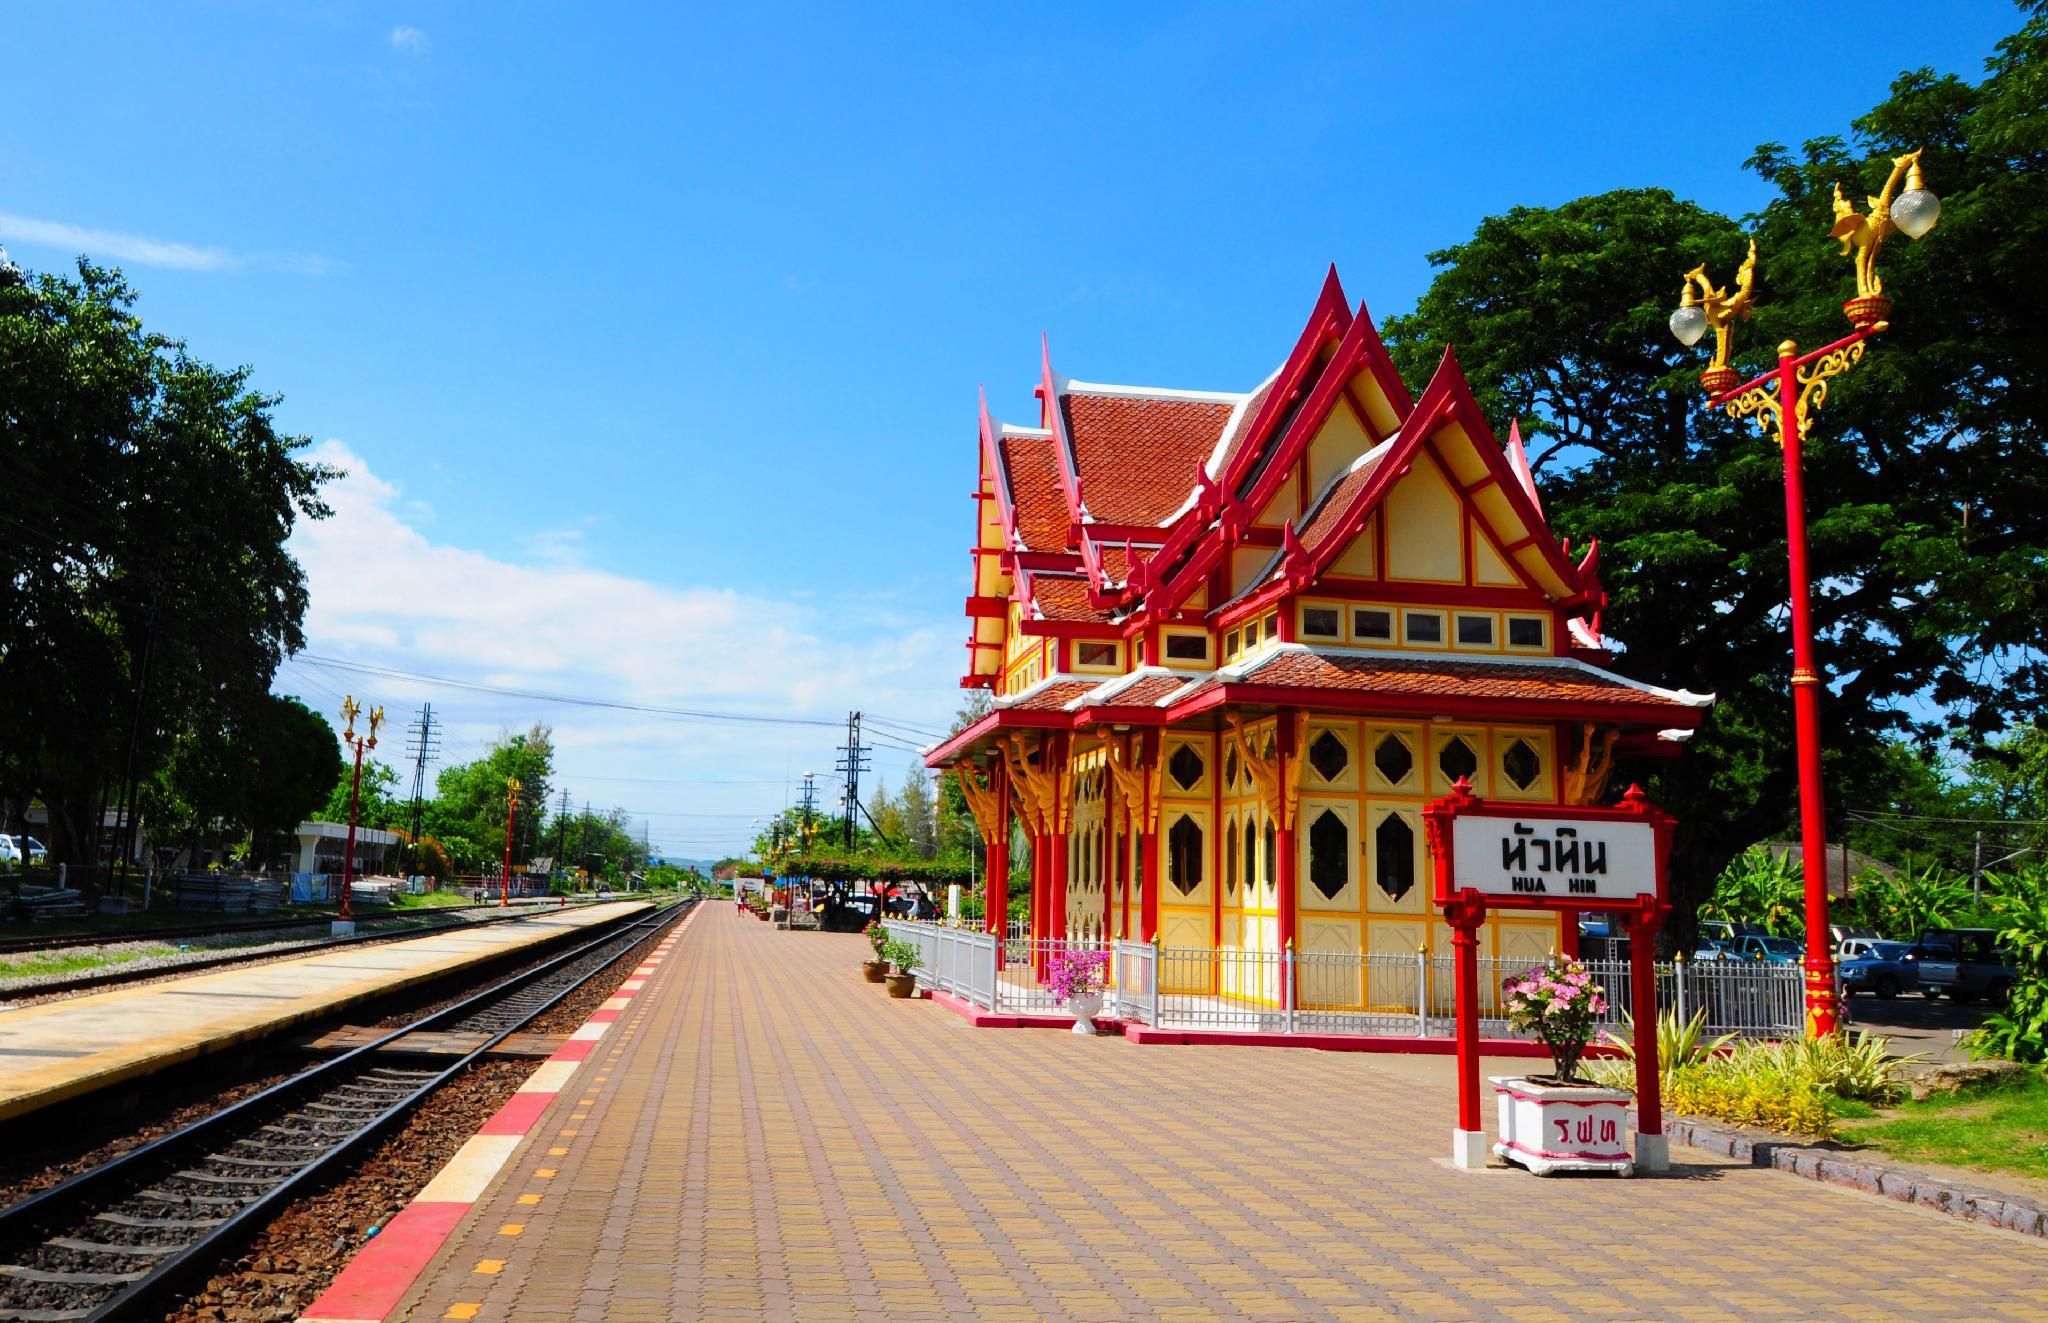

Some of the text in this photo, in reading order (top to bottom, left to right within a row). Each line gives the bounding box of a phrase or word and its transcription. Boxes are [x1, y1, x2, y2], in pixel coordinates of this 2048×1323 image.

[1501, 822, 1607, 874] หัวหิน
[1511, 876, 1597, 894] HUA HIN
